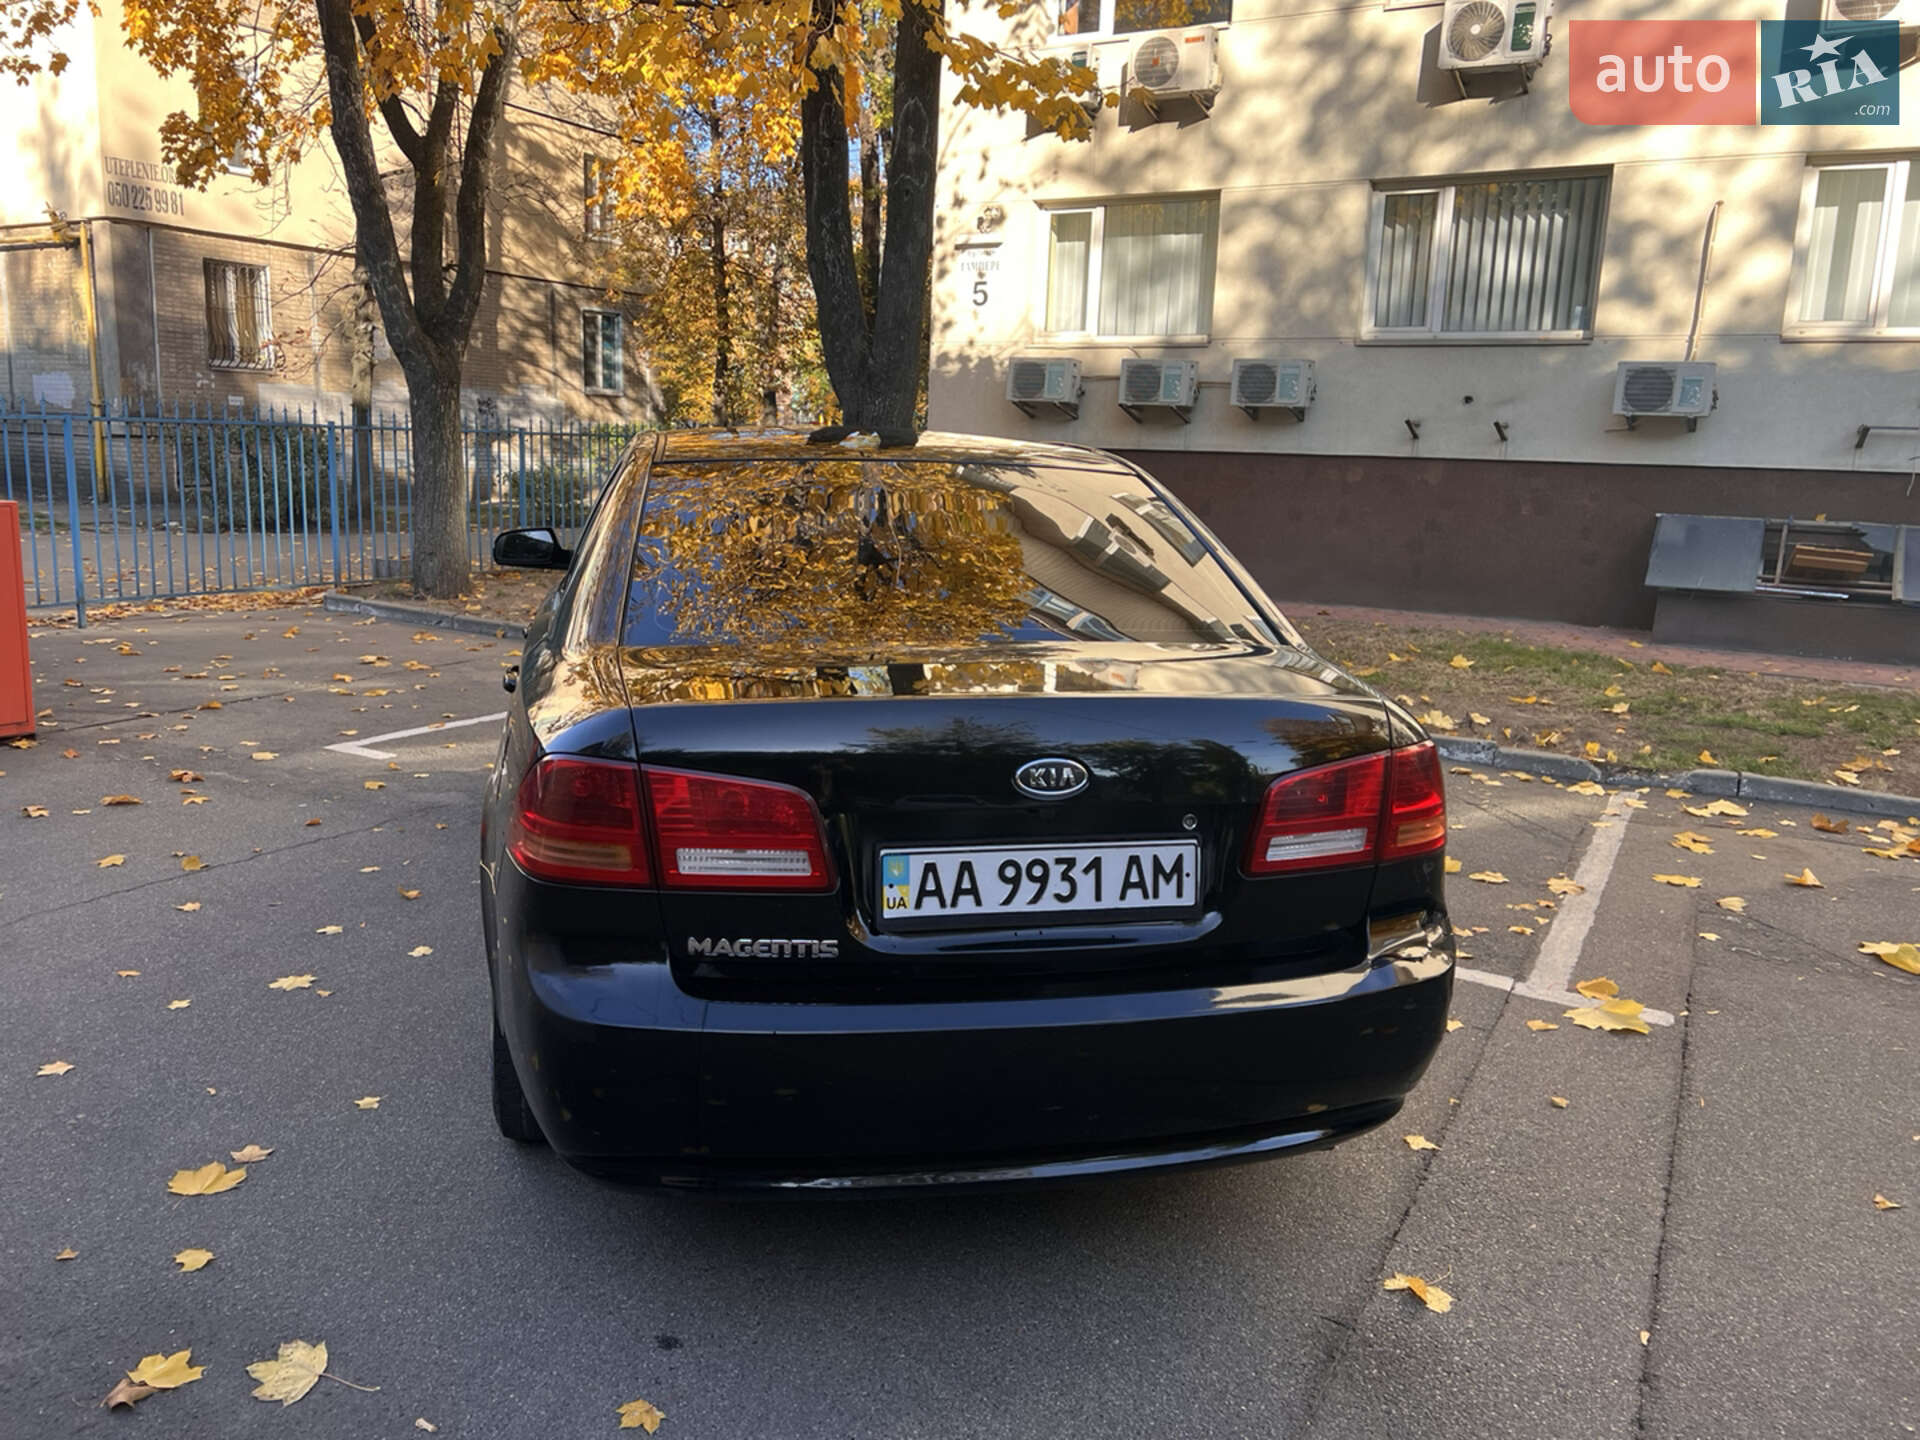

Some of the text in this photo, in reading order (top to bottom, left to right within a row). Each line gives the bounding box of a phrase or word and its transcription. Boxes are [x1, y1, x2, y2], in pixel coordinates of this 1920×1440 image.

[972, 281, 988, 306] 5
[1028, 767, 1076, 787] KIA
[914, 853, 1184, 910] AA 9931 AM
[886, 897, 908, 910] UA
[687, 936, 839, 959] MAGENTIS
